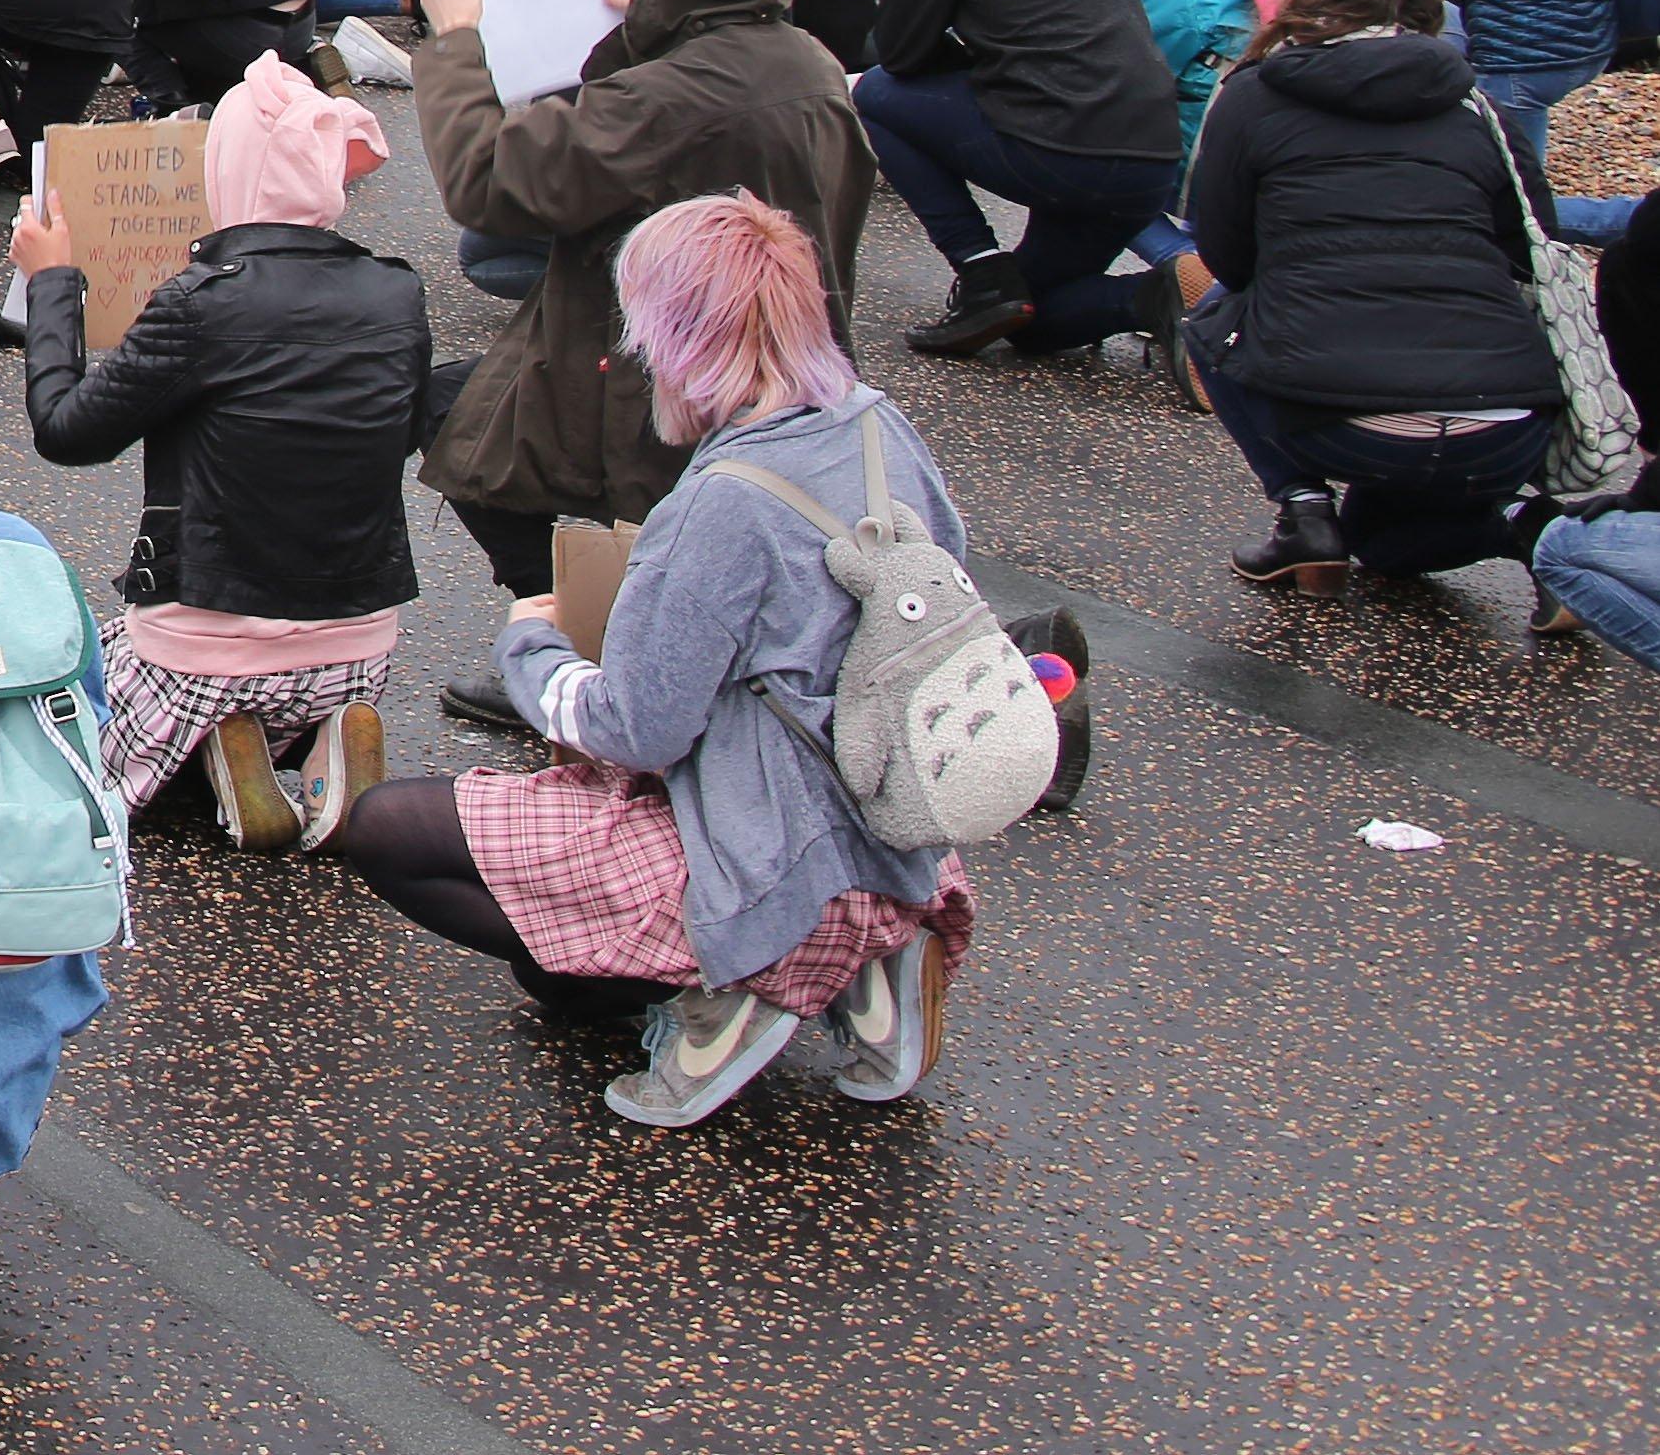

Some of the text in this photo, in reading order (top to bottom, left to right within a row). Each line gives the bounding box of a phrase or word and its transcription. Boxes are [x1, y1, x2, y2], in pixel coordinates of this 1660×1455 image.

[97, 146, 185, 172] UNITED
[94, 183, 200, 208] STAND, WE
[110, 215, 201, 238] TOGETHER
[117, 269, 135, 284] WE
